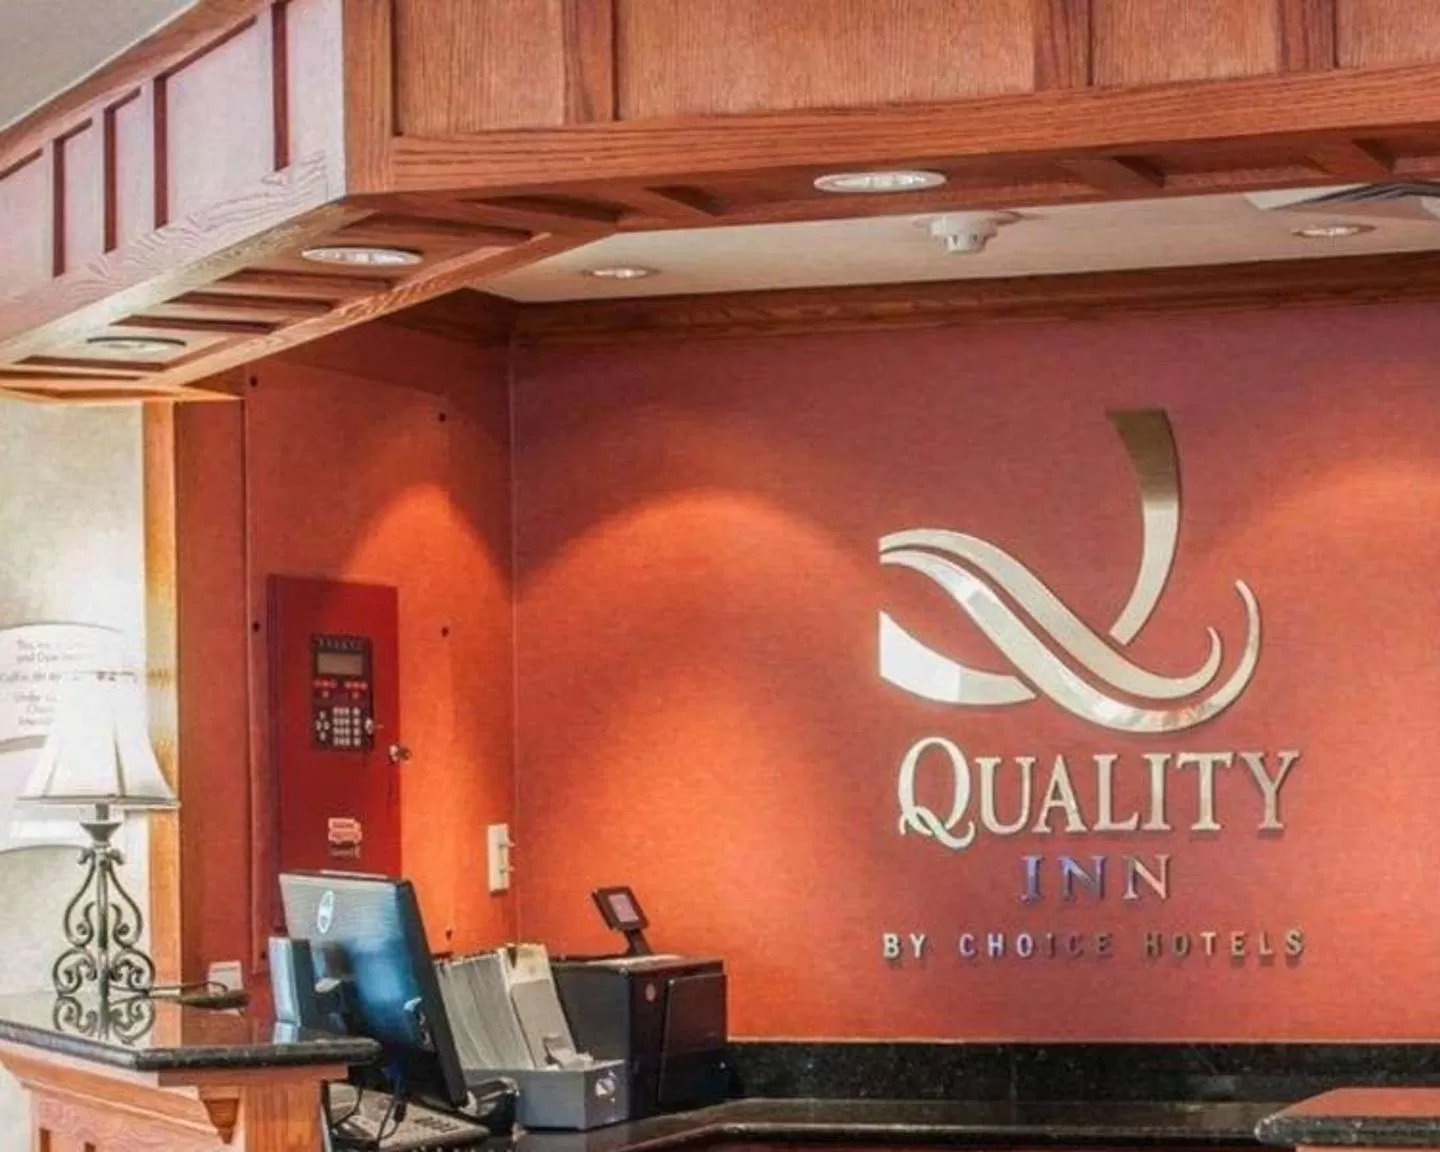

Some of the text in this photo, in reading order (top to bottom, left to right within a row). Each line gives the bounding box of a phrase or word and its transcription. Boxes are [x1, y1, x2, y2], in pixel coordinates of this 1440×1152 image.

[898, 736, 1299, 850] QUALITY
[1022, 854, 1172, 904] INN
[882, 929, 1307, 962] BY CHOICE HOTELS
